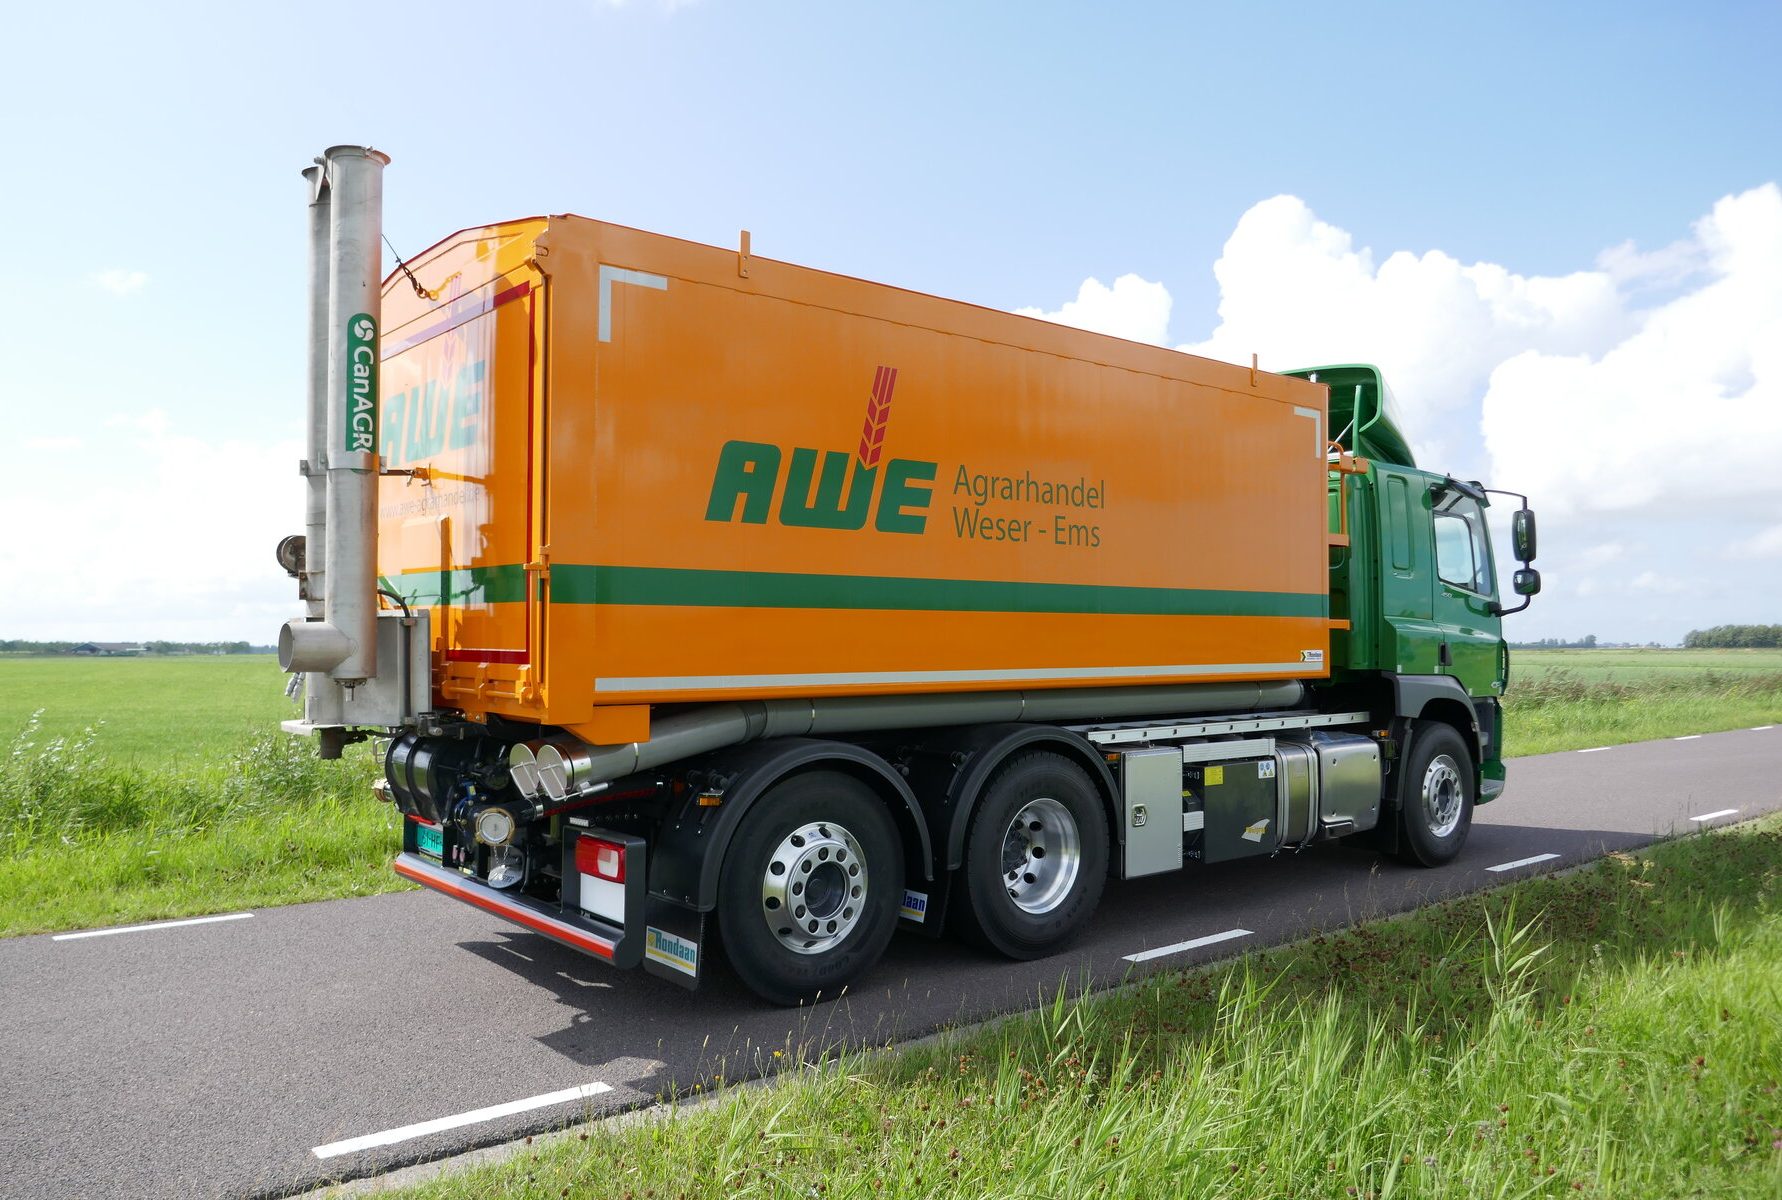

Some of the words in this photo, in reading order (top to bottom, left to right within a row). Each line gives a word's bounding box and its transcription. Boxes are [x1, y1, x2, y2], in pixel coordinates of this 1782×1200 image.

[352, 346, 374, 453] CanAGR
[380, 360, 486, 467] AWE
[704, 439, 939, 535] AWE
[953, 464, 1106, 510] Agrarhandel
[953, 506, 1032, 545] Weser
[1054, 515, 1101, 548] Ems
[648, 928, 696, 964] Rondaan
